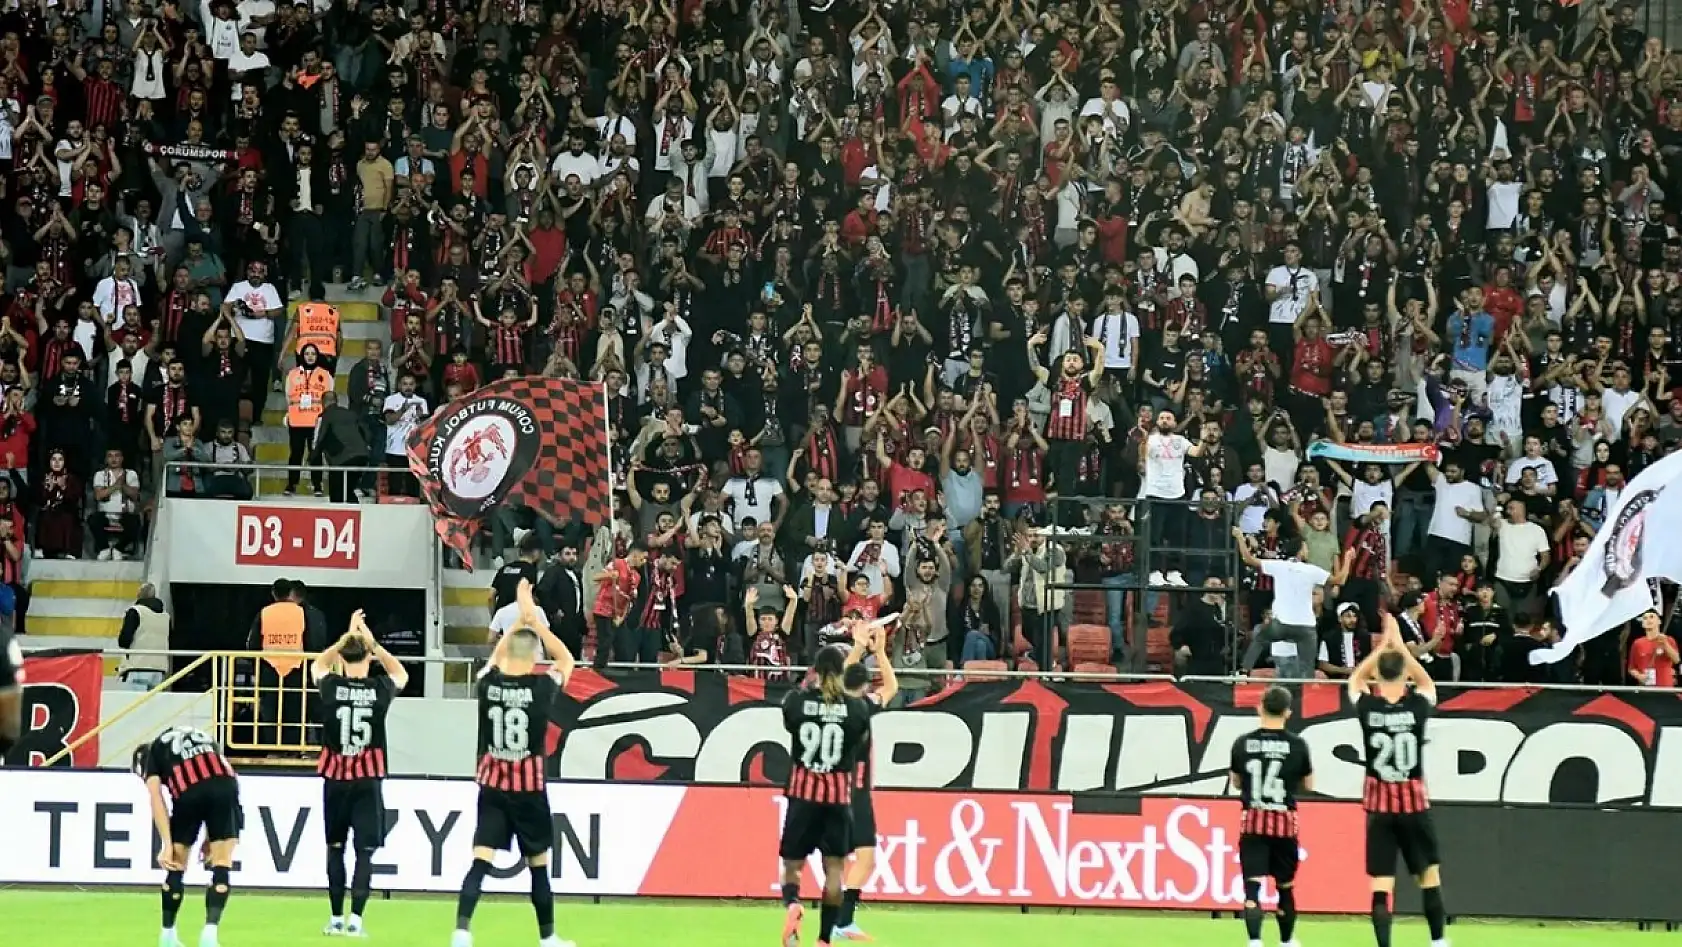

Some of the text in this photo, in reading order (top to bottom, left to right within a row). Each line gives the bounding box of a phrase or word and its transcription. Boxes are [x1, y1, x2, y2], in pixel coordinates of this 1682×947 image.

[240, 514, 283, 557] D3
[313, 517, 356, 560] D4
[336, 706, 373, 747] 15
[488, 705, 529, 751] 18
[799, 721, 845, 767] 90
[1369, 732, 1418, 776] 20
[1246, 758, 1286, 803] 14
[934, 799, 1004, 897] &
